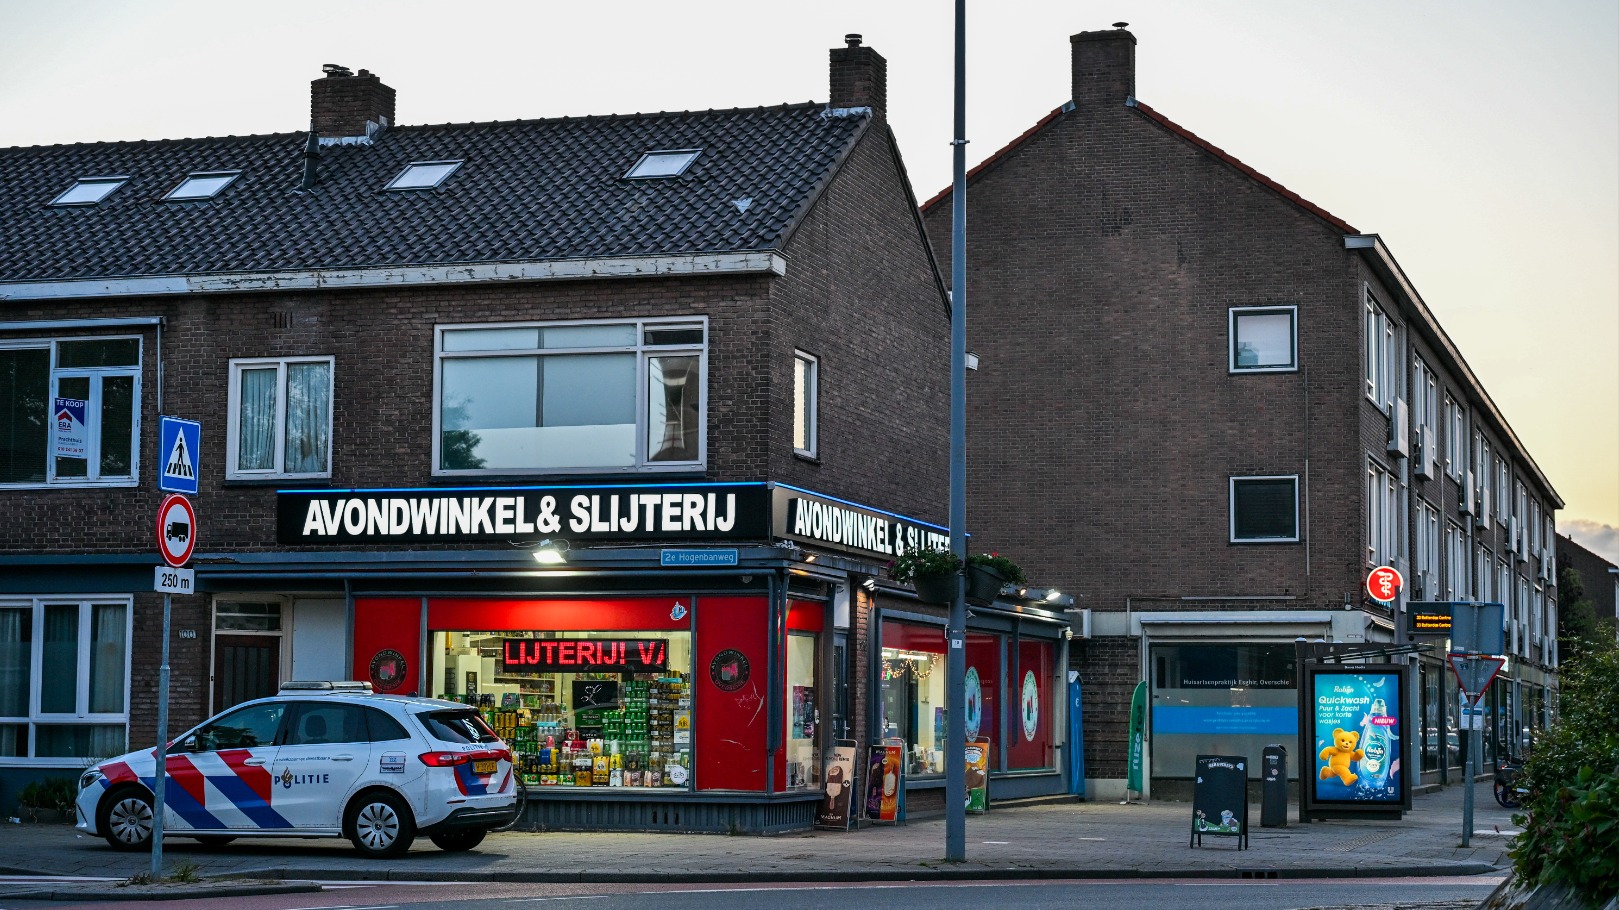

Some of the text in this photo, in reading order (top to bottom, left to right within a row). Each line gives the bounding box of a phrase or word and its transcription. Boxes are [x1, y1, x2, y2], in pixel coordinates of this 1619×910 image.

[302, 493, 736, 536] AVONDWINKEL & SLIJTERIJ
[794, 497, 893, 555] AVONDWINKEL
[895, 522, 904, 558] &
[664, 552, 734, 564] 2e Hogenbanweg
[162, 572, 190, 589] 250 m
[372, 650, 406, 668] AVONDWINKEL
[506, 642, 626, 665] LIJTERIJ!
[711, 650, 748, 670] AVONDWINKEL
[1318, 696, 1370, 704] Quickwash
[274, 773, 329, 788] POLITIE
